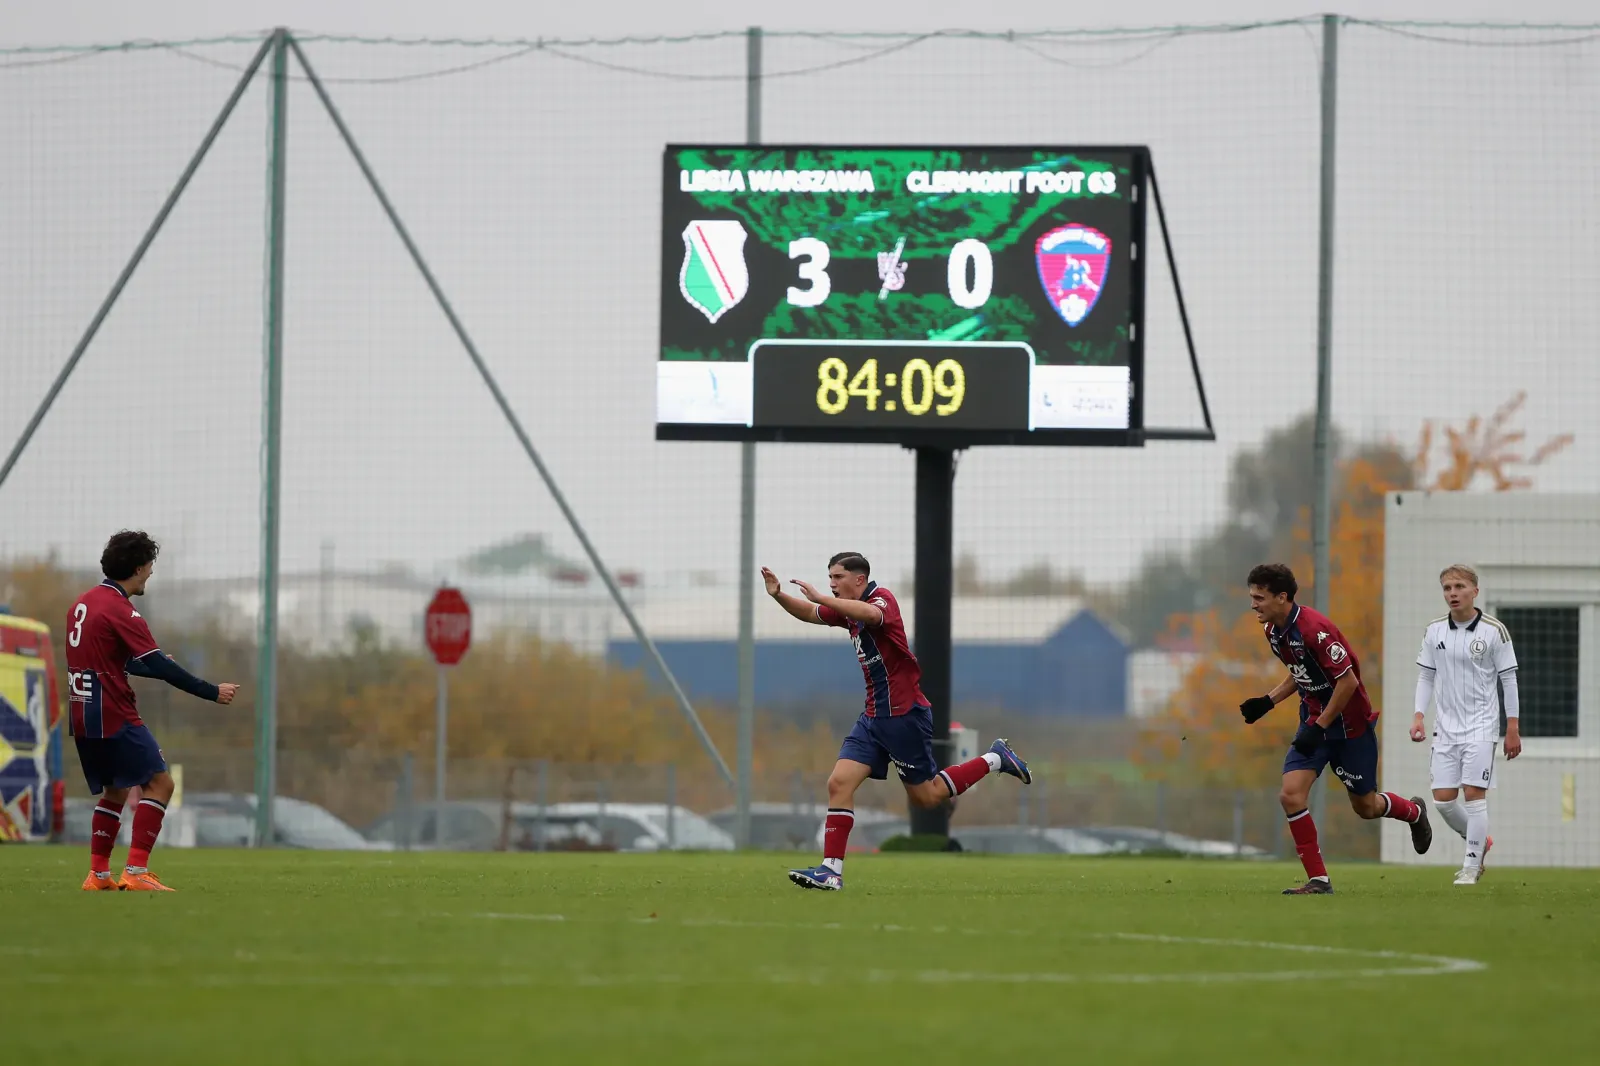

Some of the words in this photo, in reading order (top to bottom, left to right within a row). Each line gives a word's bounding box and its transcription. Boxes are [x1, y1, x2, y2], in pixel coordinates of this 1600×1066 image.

[680, 170, 746, 192] LEGIA
[747, 170, 875, 193] WARSZAWA
[906, 171, 1024, 194] CLERMONT
[1026, 171, 1085, 194] FOOT
[1087, 171, 1116, 194] 63
[786, 237, 831, 307] 3
[947, 239, 993, 309] 0
[816, 357, 966, 417] 84:09
[67, 602, 88, 648] 3
[429, 612, 470, 640] STOP
